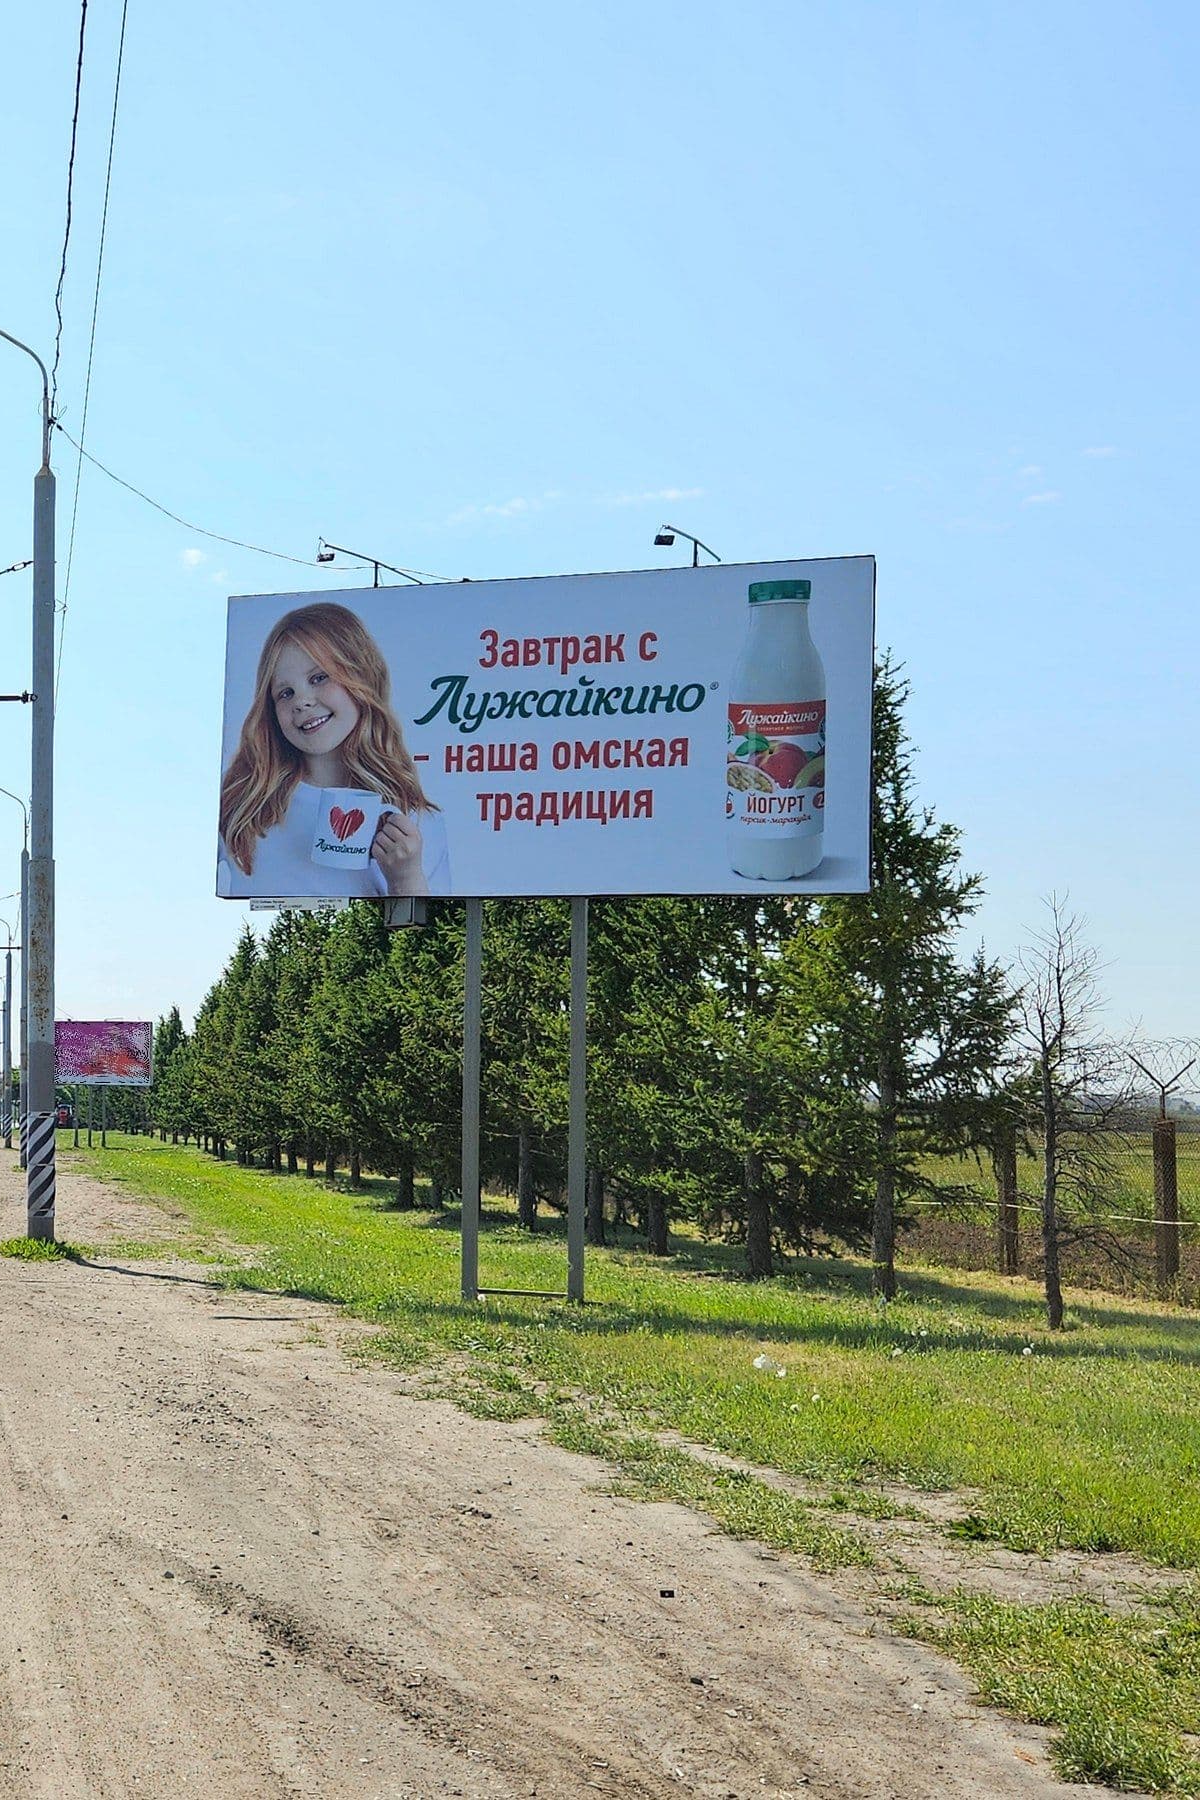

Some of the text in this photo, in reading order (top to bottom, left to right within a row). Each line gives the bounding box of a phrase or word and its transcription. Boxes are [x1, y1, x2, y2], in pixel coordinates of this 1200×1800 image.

[479, 629, 658, 675] Завтрак с
[738, 709, 818, 728] Лужайкино
[445, 742, 538, 773] наша
[552, 738, 689, 769] омская
[476, 790, 653, 831] традиция
[747, 793, 805, 814] ЙОГУРТ
